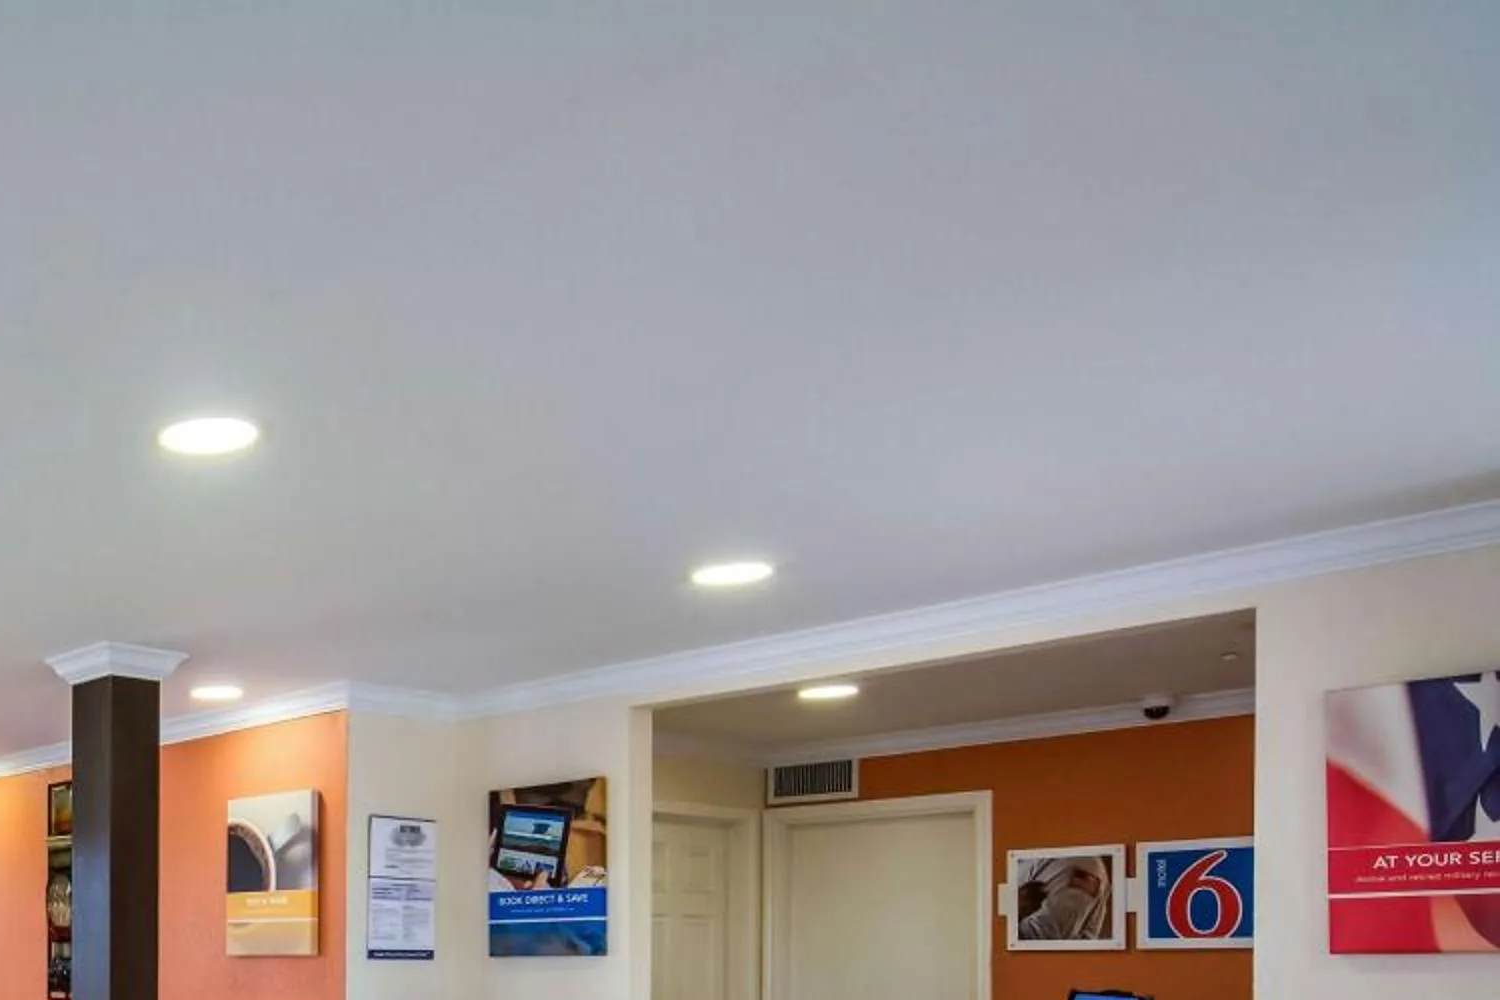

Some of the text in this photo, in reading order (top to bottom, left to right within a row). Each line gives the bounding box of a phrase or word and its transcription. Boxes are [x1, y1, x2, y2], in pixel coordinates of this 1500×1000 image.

[1373, 855, 1399, 869] AT
[1405, 851, 1462, 867] YOUR
[1388, 872, 1407, 882] and
[499, 892, 589, 907] BOOK DIRECT & SAVE
[1166, 849, 1243, 939] 6
